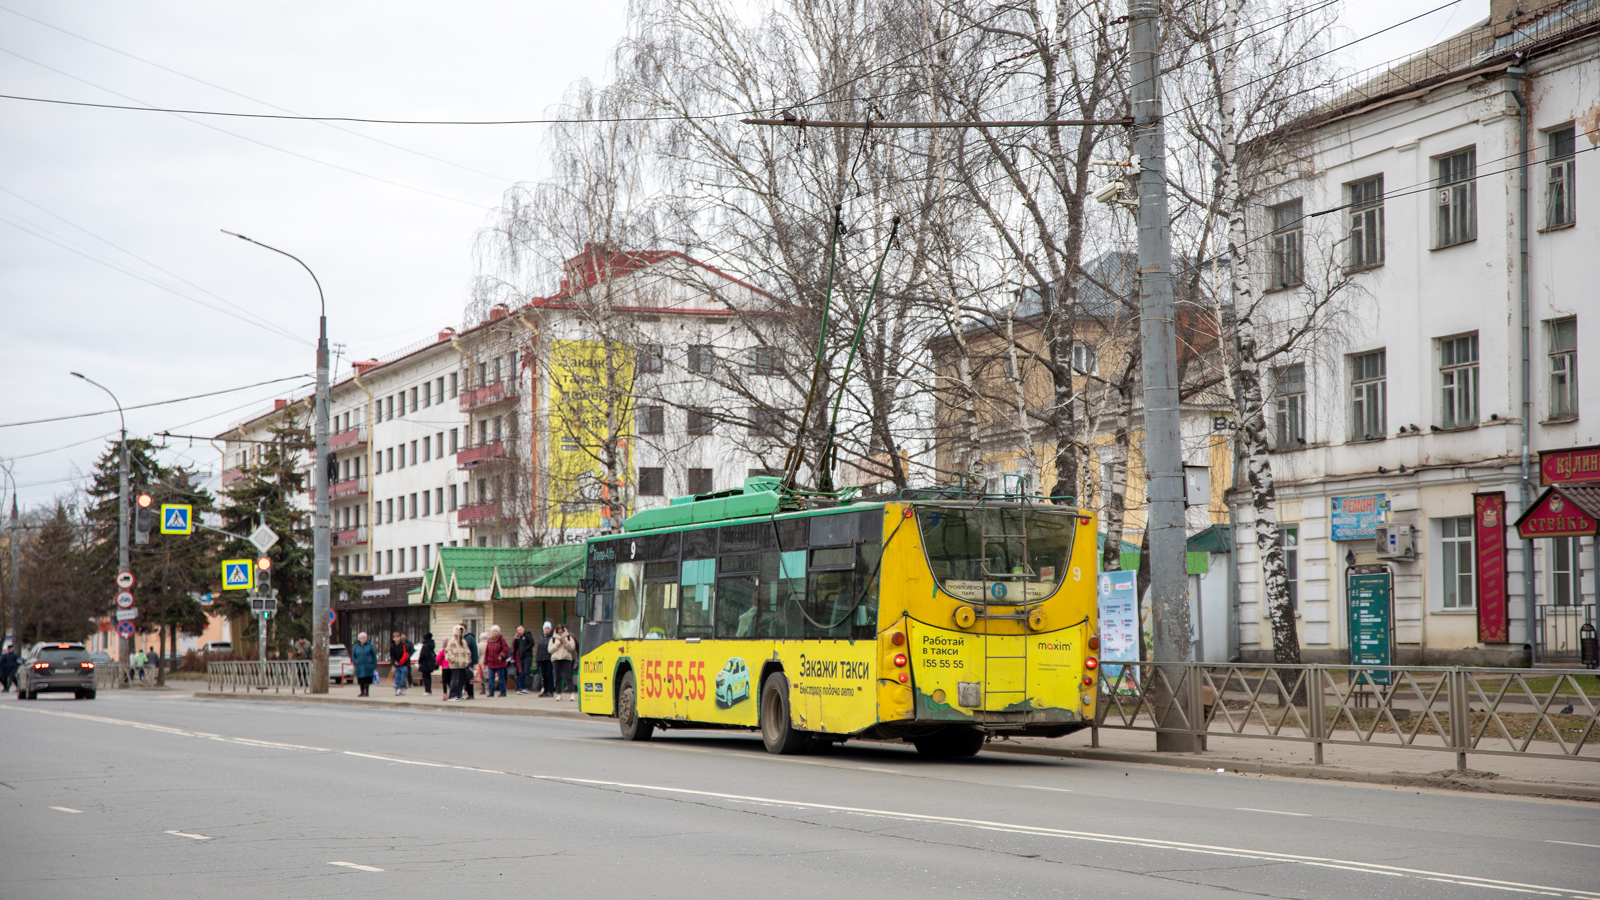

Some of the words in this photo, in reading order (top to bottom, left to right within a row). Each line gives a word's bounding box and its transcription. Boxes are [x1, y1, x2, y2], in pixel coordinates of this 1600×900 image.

[1342, 497, 1378, 514] РЕМОНТ
[930, 512, 939, 527] 9
[1528, 514, 1588, 532] СТЕЙКЪ
[630, 541, 636, 559] 9
[1072, 566, 1081, 581] 9
[995, 584, 1004, 598] 6
[923, 635, 964, 646] Работай
[1038, 640, 1071, 651] maxim
[583, 657, 604, 673] maxim
[799, 653, 838, 679] Закажи
[840, 661, 870, 680] такси
[799, 682, 822, 694] Быстрая
[823, 683, 840, 696] подача
[841, 688, 855, 697] авто
